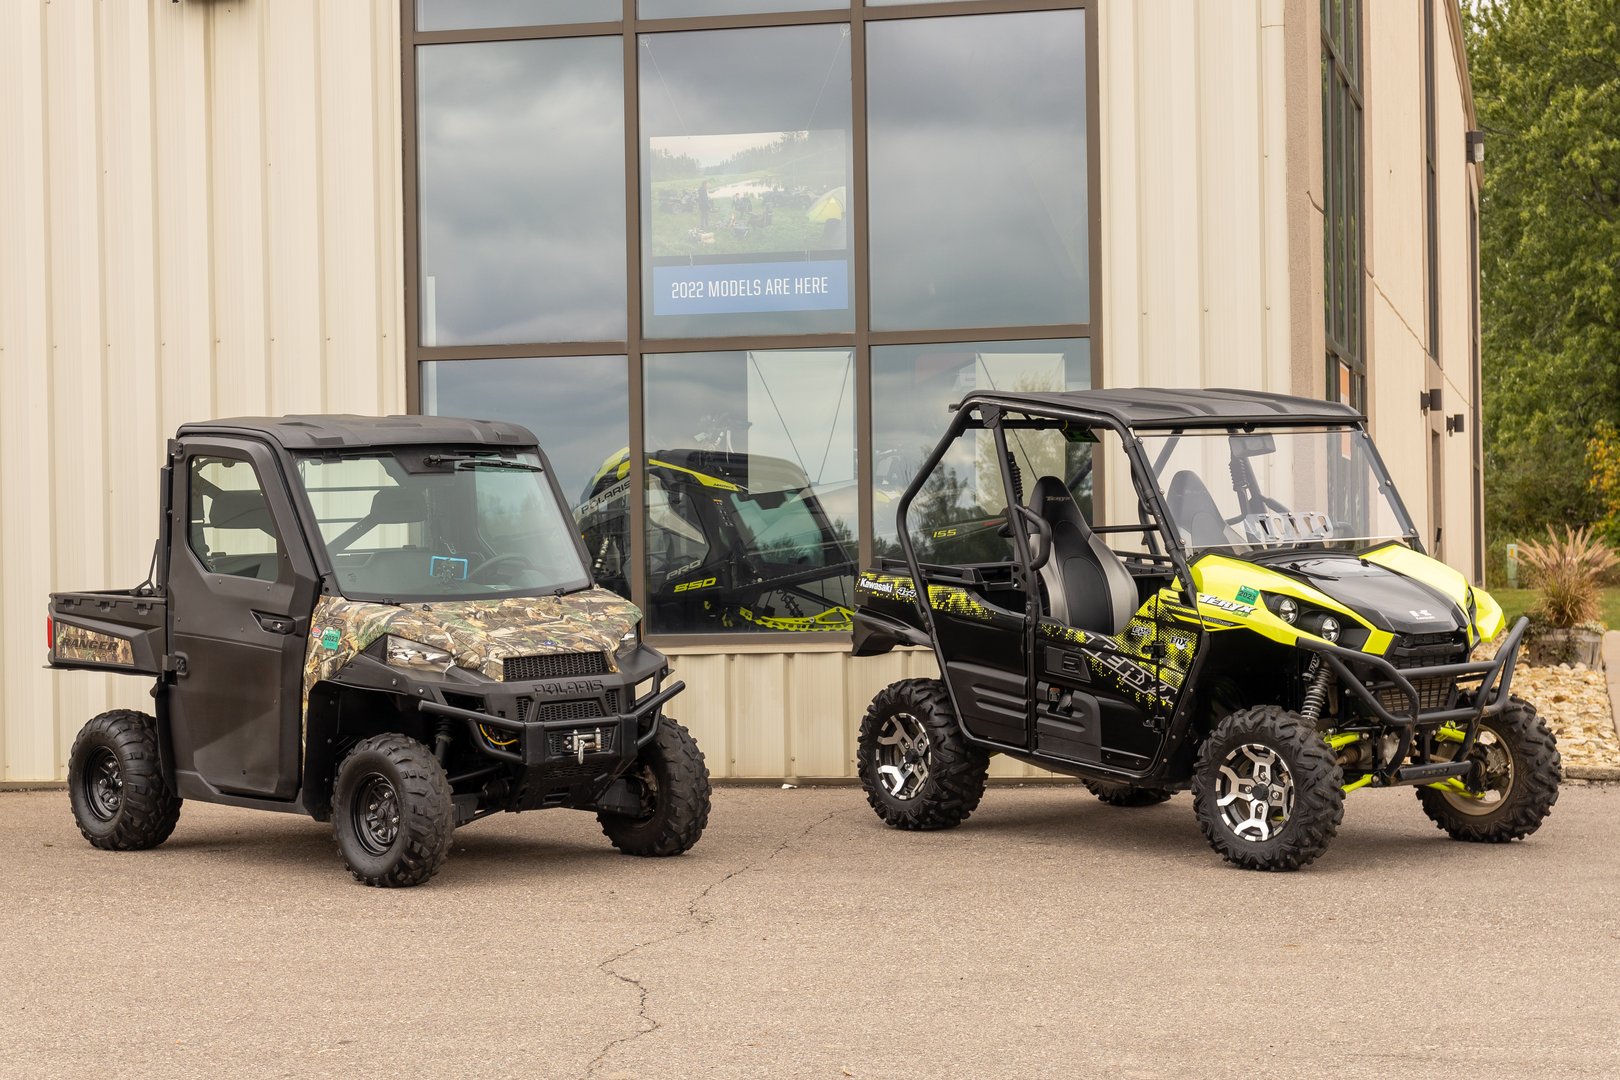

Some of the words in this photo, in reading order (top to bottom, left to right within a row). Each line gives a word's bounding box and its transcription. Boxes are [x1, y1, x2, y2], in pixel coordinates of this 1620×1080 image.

[671, 281, 704, 299] 2022
[708, 279, 762, 298] MODELS
[765, 278, 790, 295] ARE
[795, 277, 829, 294] HERE
[581, 480, 631, 515] POLARIS
[933, 529, 957, 538] 155
[666, 559, 701, 580] PRO
[673, 577, 717, 593] 850
[860, 577, 894, 593] Kawasaki
[1239, 590, 1257, 601] 2023
[61, 637, 119, 651] RANGER
[324, 634, 339, 643] 2023
[532, 679, 603, 696] POLARIS
